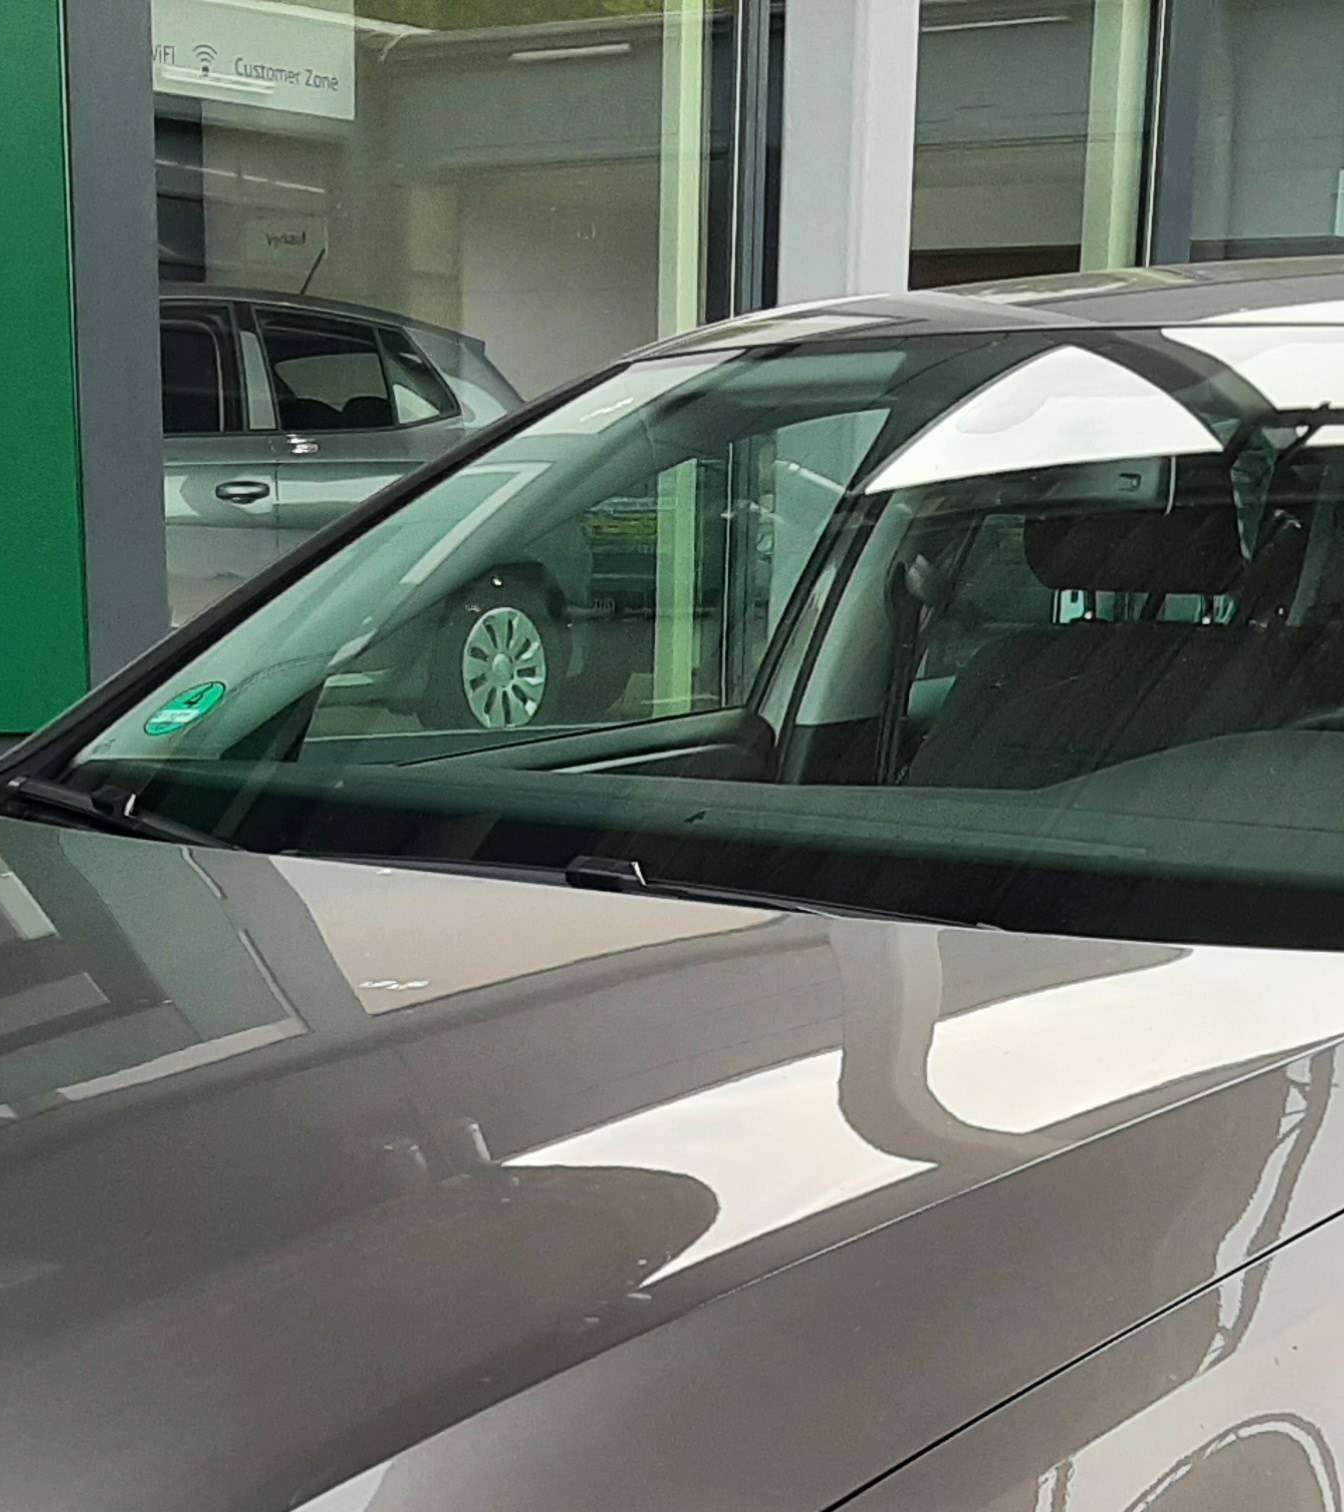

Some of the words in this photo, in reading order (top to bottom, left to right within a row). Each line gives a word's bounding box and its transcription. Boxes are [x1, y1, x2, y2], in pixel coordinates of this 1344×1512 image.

[234, 57, 301, 84] Customer
[305, 69, 339, 91] Zone
[184, 682, 214, 709] 4
